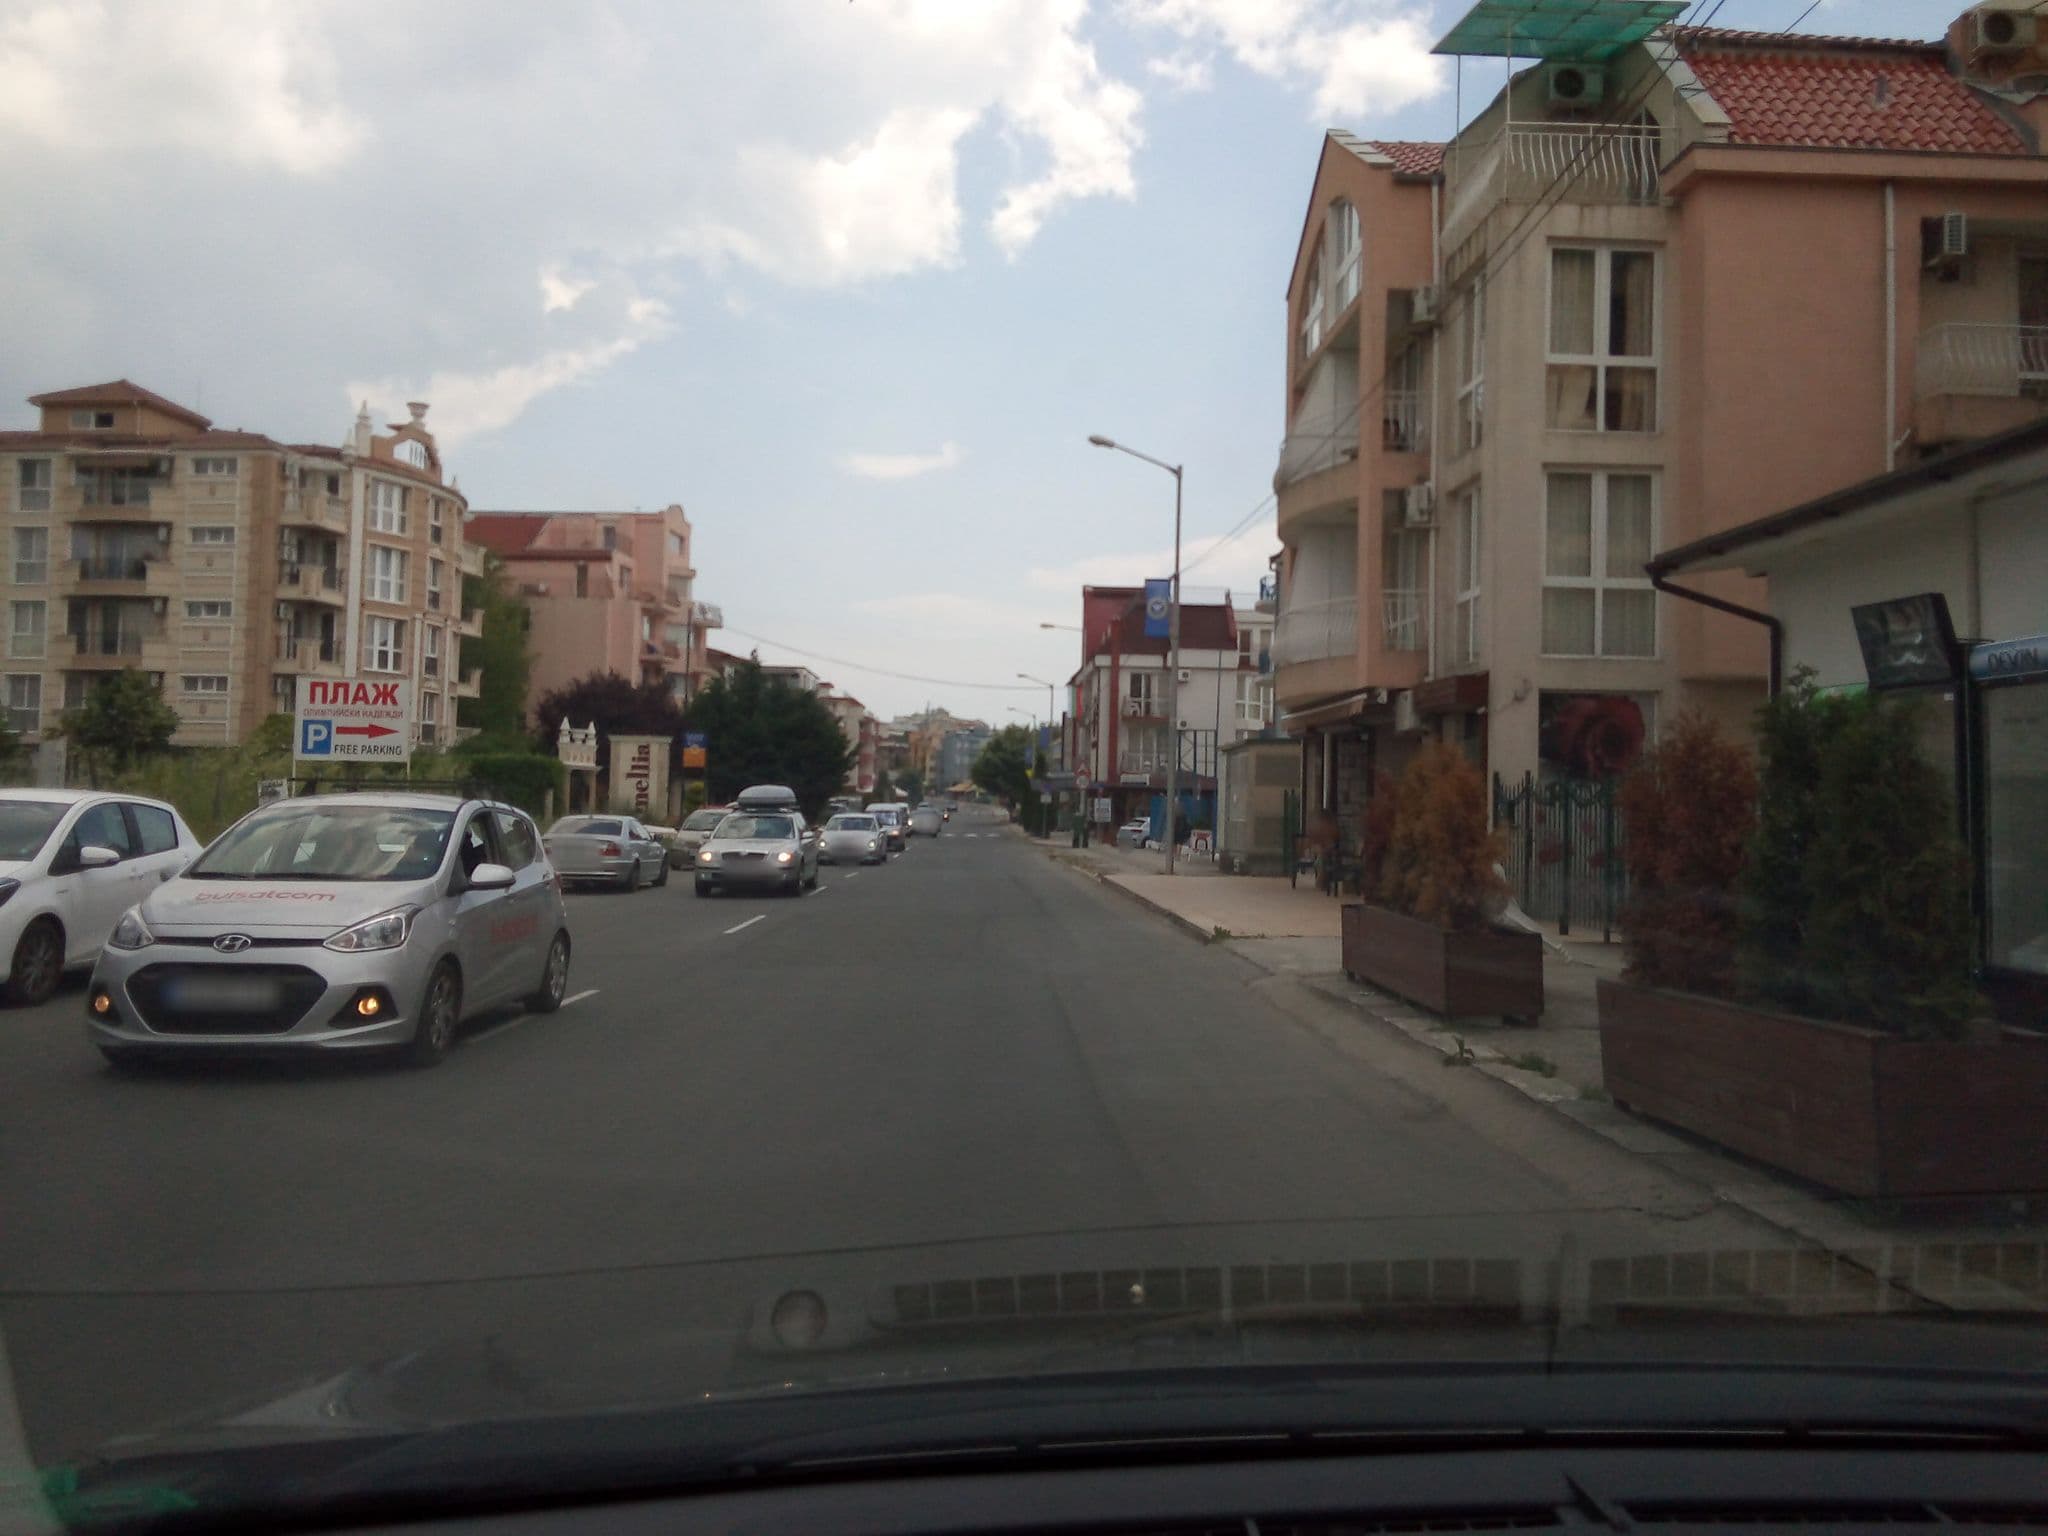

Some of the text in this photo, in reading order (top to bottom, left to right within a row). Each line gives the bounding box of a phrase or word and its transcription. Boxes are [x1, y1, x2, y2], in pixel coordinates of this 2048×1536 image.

[309, 681, 400, 706] ПЛАЖ
[307, 724, 328, 750] P
[334, 744, 402, 756] FREE PARKING
